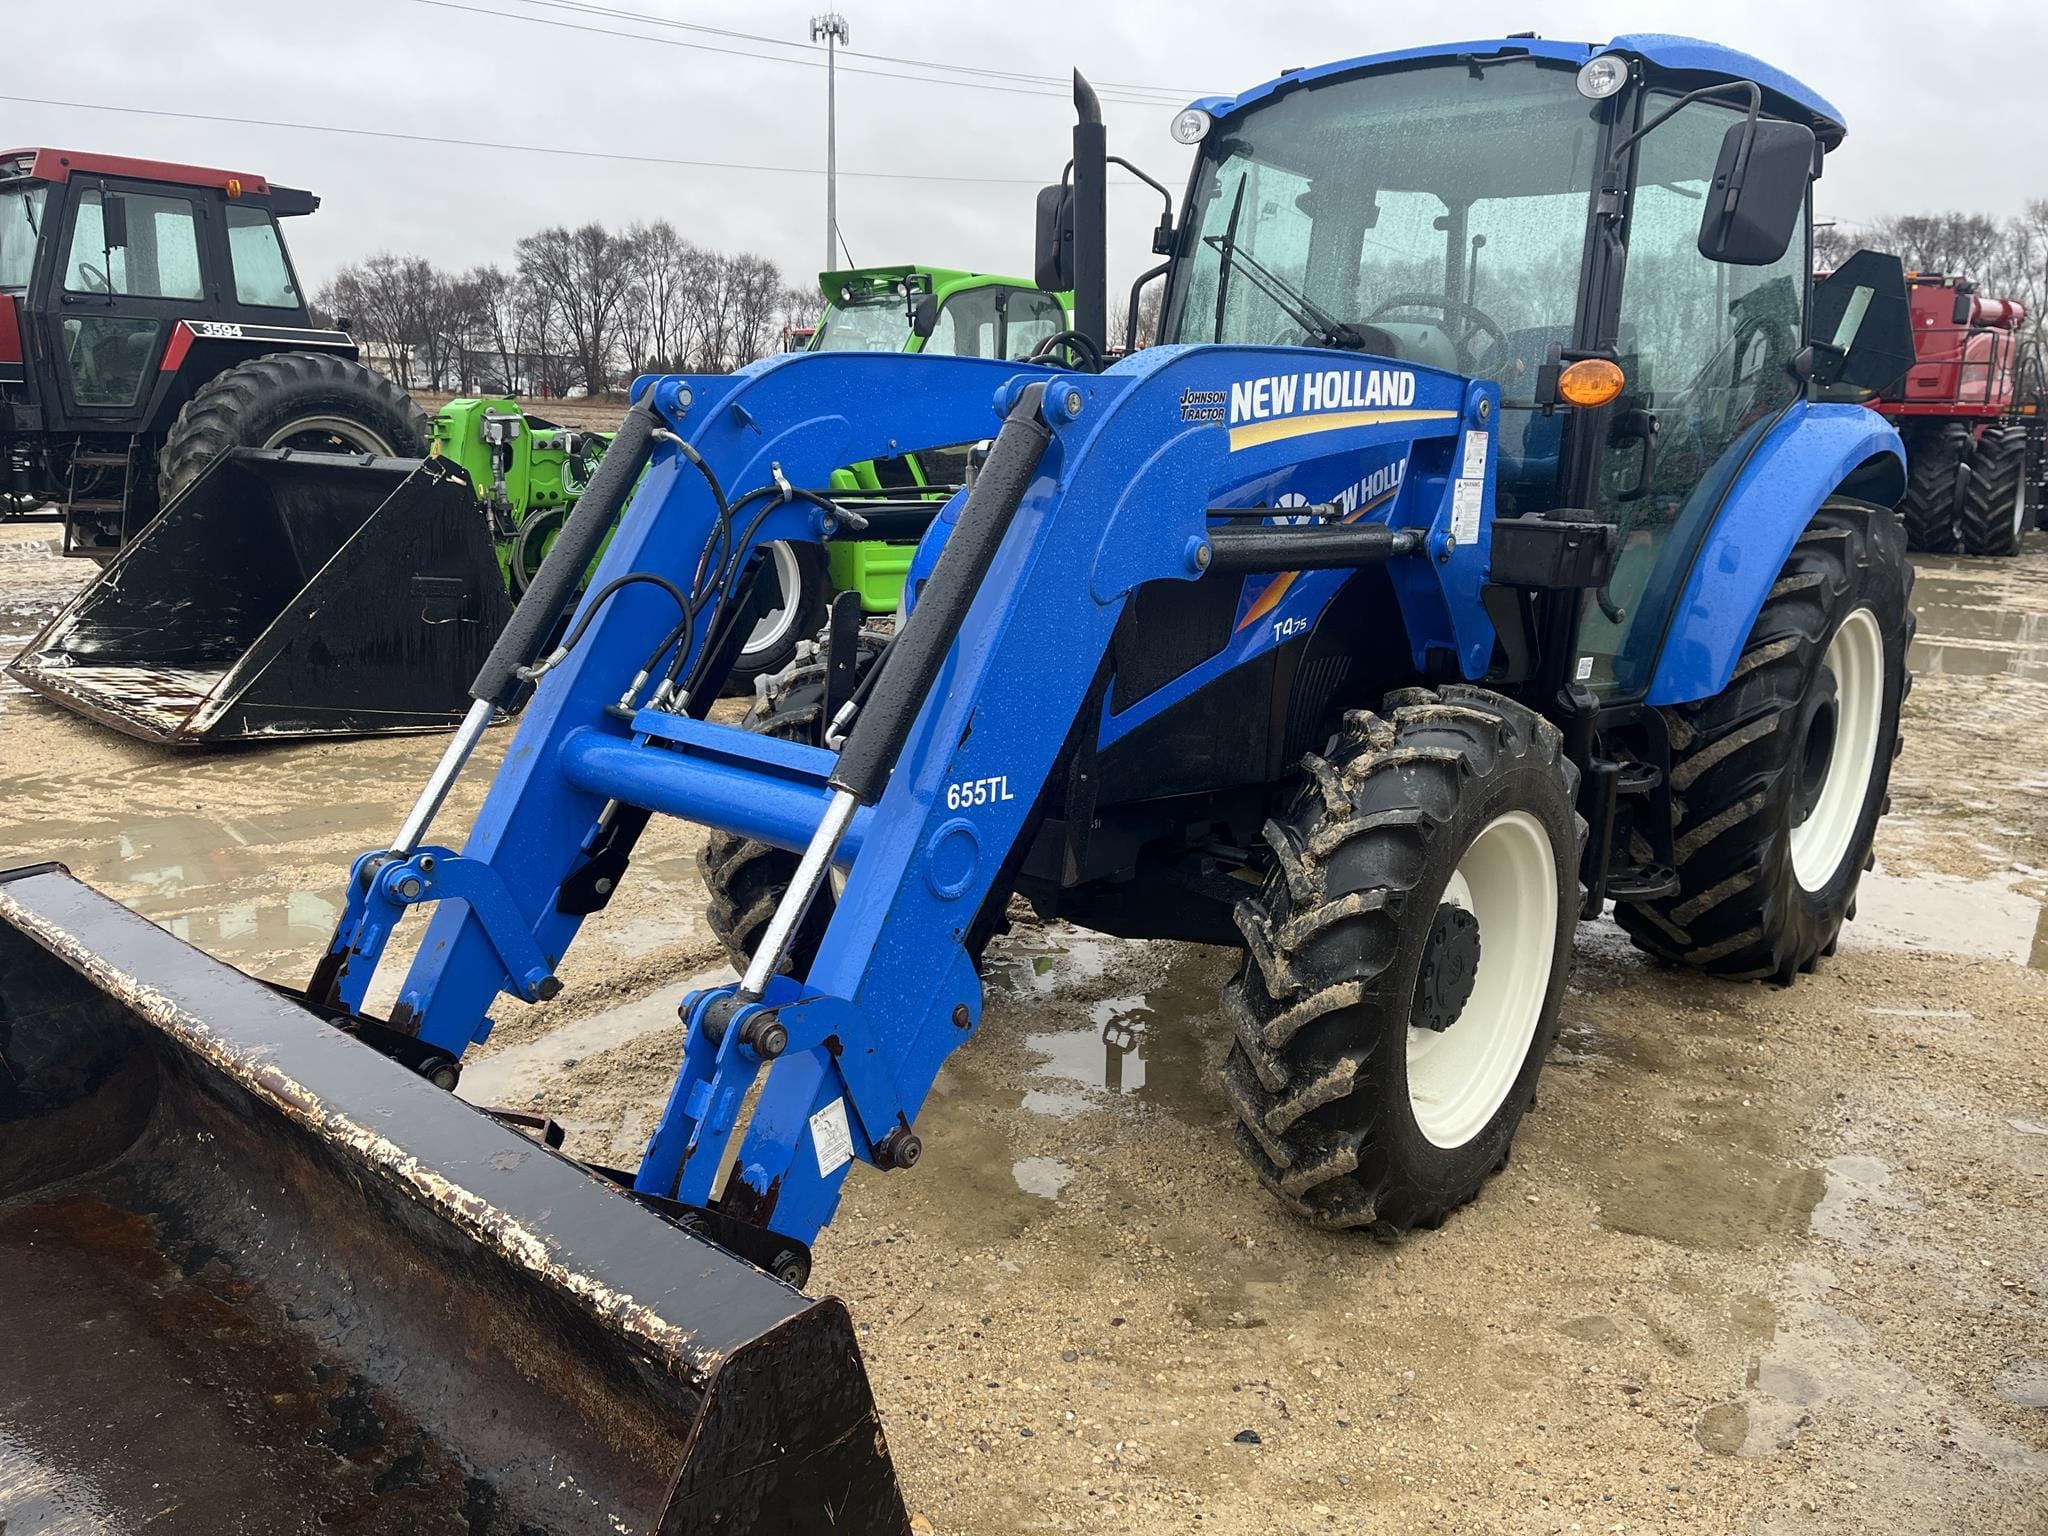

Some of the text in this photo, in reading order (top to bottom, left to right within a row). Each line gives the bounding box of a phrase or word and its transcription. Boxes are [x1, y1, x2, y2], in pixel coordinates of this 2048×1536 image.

[202, 323, 243, 337] 3594
[1180, 388, 1226, 404] JOHNSON
[1230, 370, 1416, 423] NEW HOLLAND
[1180, 405, 1225, 421] TRACTOR
[947, 775, 1014, 810] 655TL
